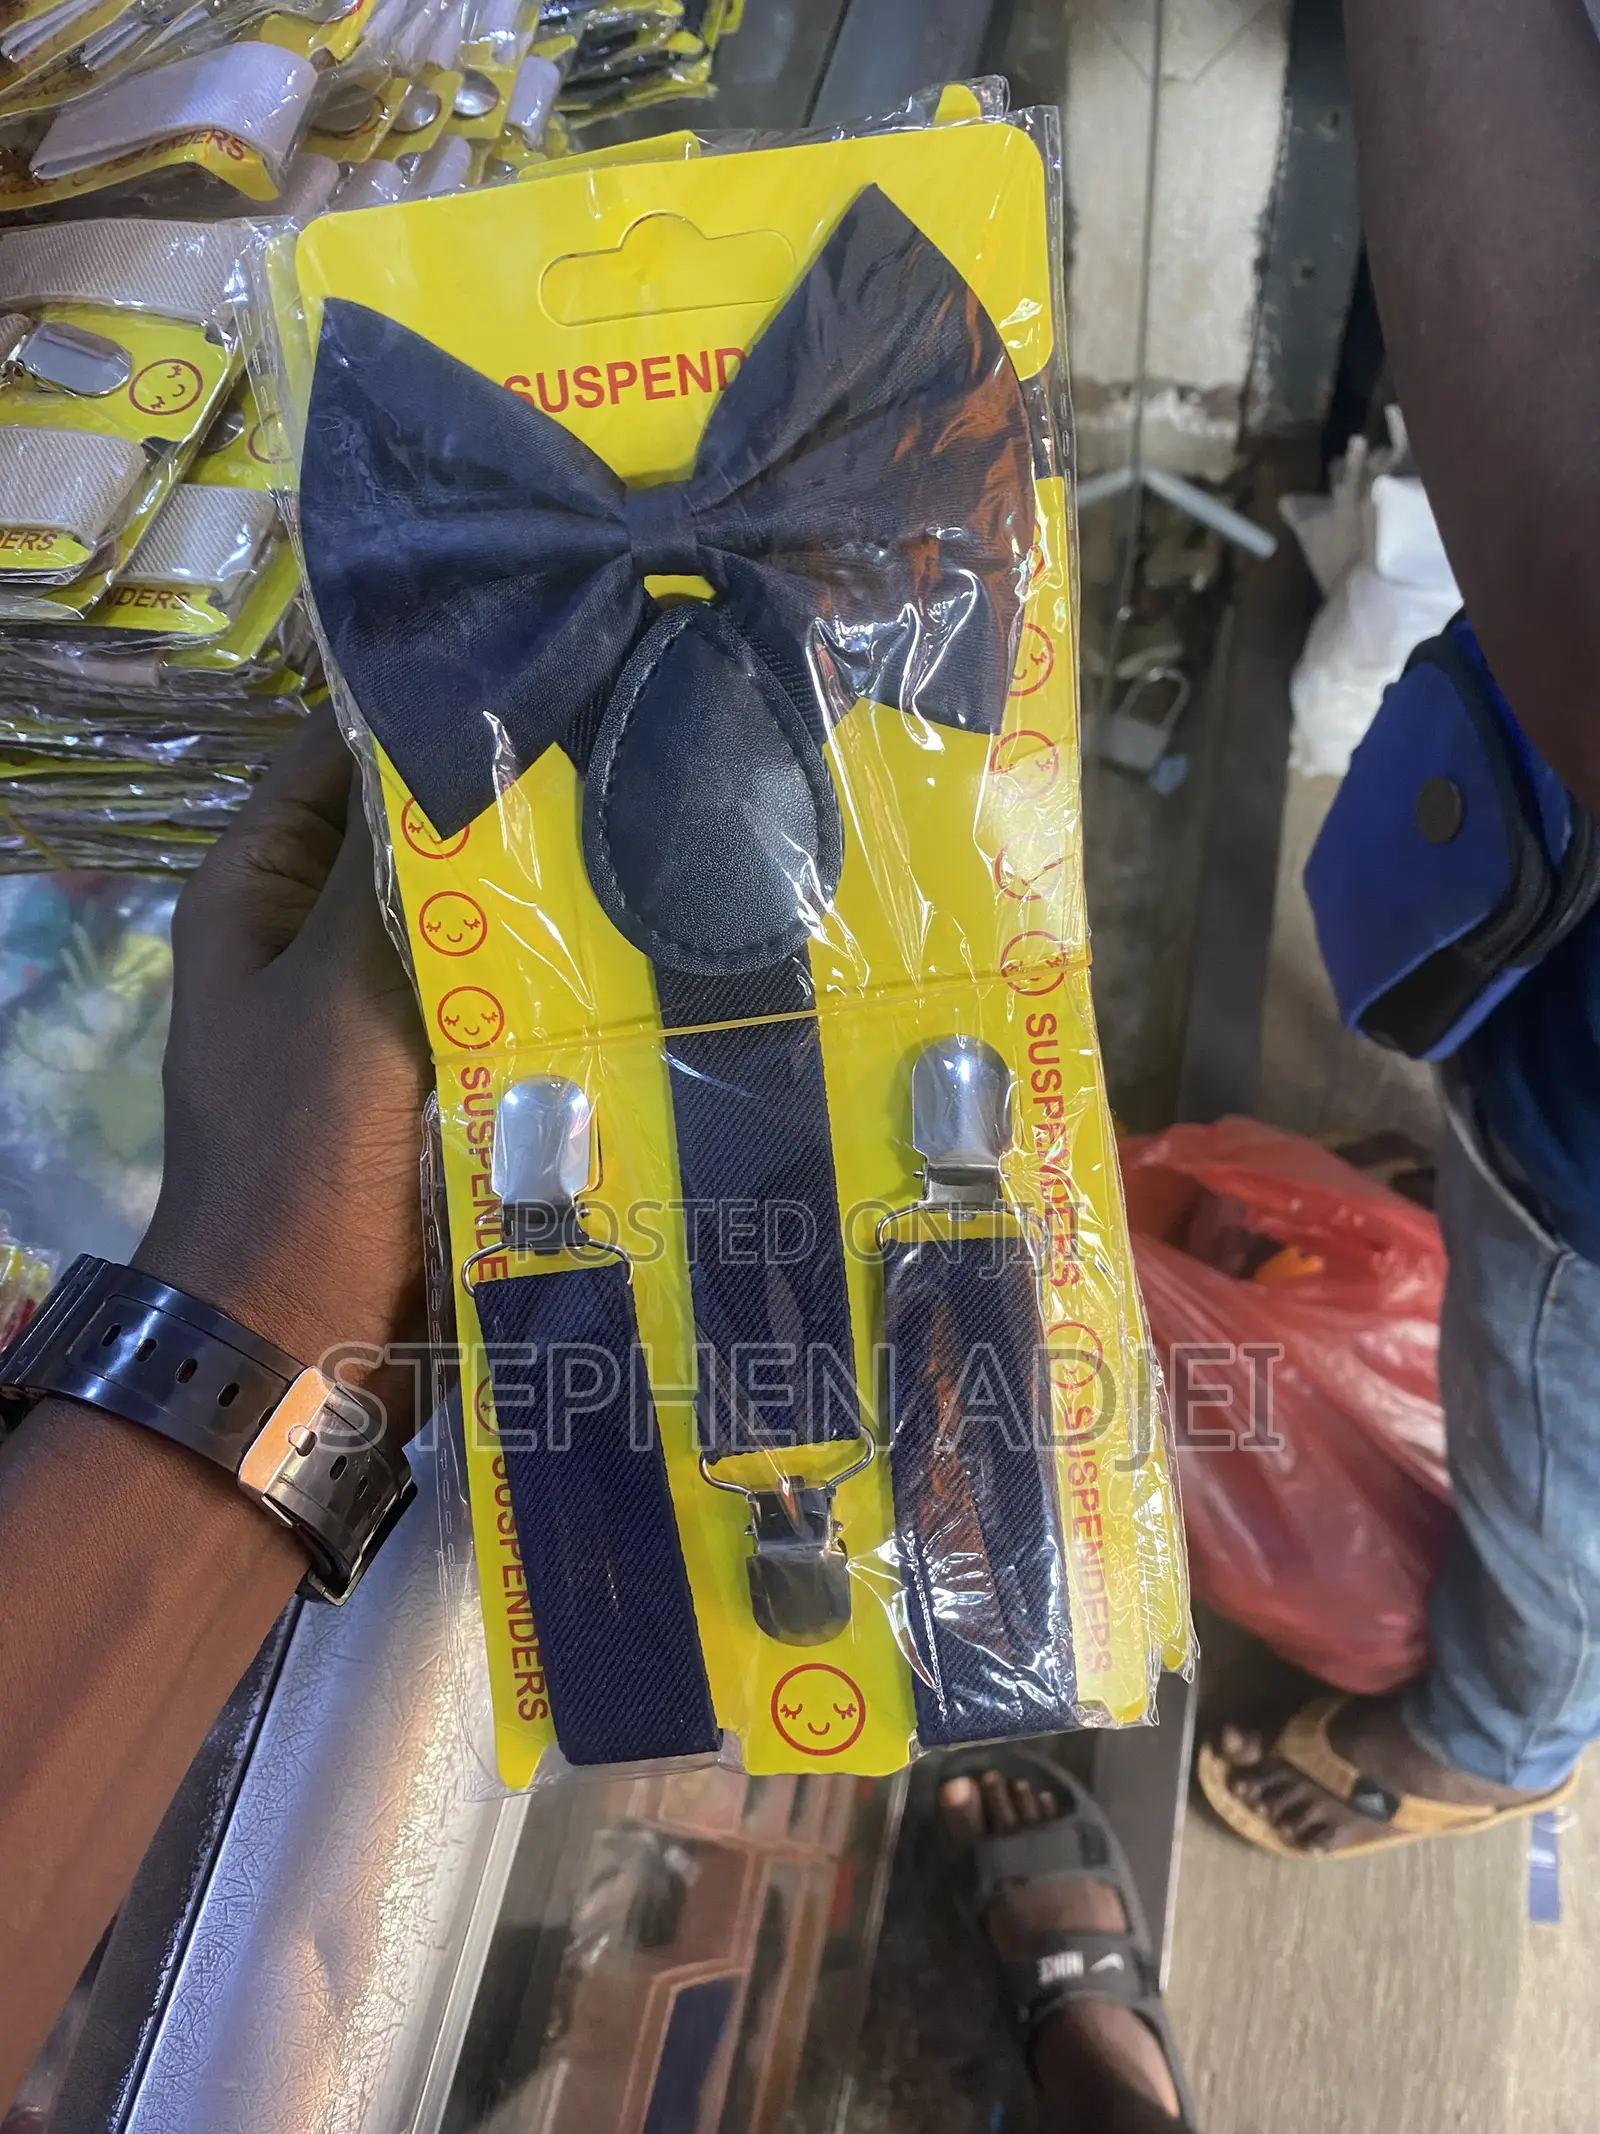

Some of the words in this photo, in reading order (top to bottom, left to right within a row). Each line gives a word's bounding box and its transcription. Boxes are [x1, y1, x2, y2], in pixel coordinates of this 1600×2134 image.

[502, 347, 748, 413] SUSPEND
[0, 530, 57, 551] ERS
[1064, 1406, 1112, 1674] SUSPENDERS
